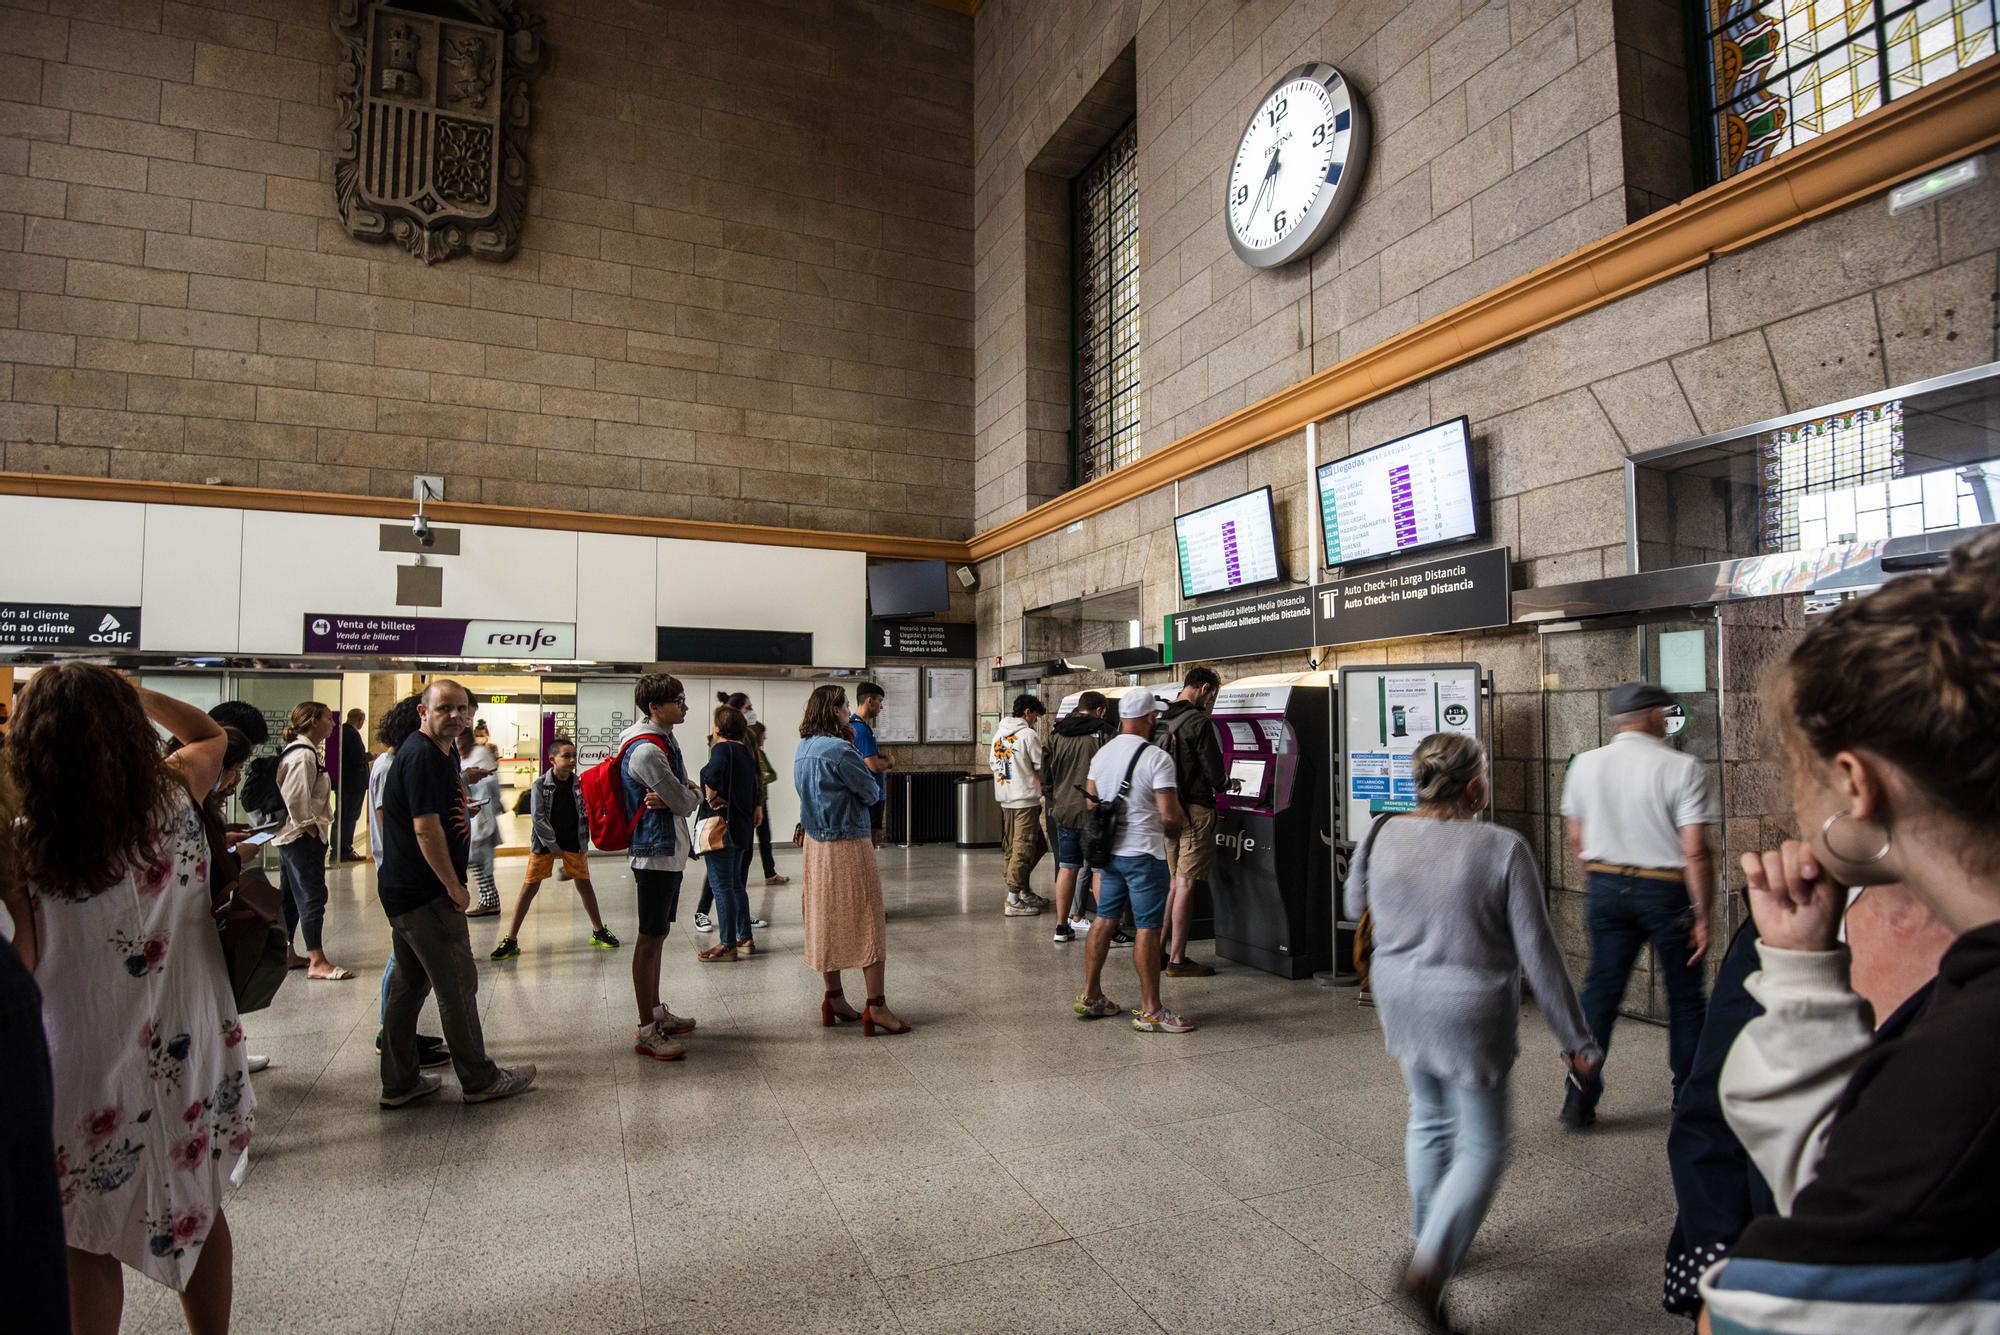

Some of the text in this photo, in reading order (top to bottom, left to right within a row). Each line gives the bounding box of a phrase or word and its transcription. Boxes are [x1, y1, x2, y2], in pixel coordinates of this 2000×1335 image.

[1267, 98, 1289, 128] 12
[1312, 123, 1326, 148] 3
[1237, 184, 1249, 206] 9
[1274, 209, 1287, 233] 6
[1344, 565, 1466, 596] Auto Check-in Larga Distancia
[1344, 578, 1474, 609] Auto Check-in Longa Distancia
[20, 609, 30, 619] al
[33, 610, 70, 620] cliente
[1191, 594, 1305, 623] Venta automática billetes Media Distancia
[1191, 606, 1311, 634] Venda automática billetes Media Distancia
[20, 624, 34, 632] ao
[38, 623, 75, 634] cliente
[336, 619, 416, 631] Venta de billetes
[336, 631, 401, 641] Venda de billetes
[21, 635, 60, 643] SERVICE
[88, 631, 133, 643] adif
[336, 642, 379, 651] Tickets sale
[487, 627, 557, 652] renfe
[581, 748, 609, 760] renfe
[1215, 829, 1255, 861] enfe
